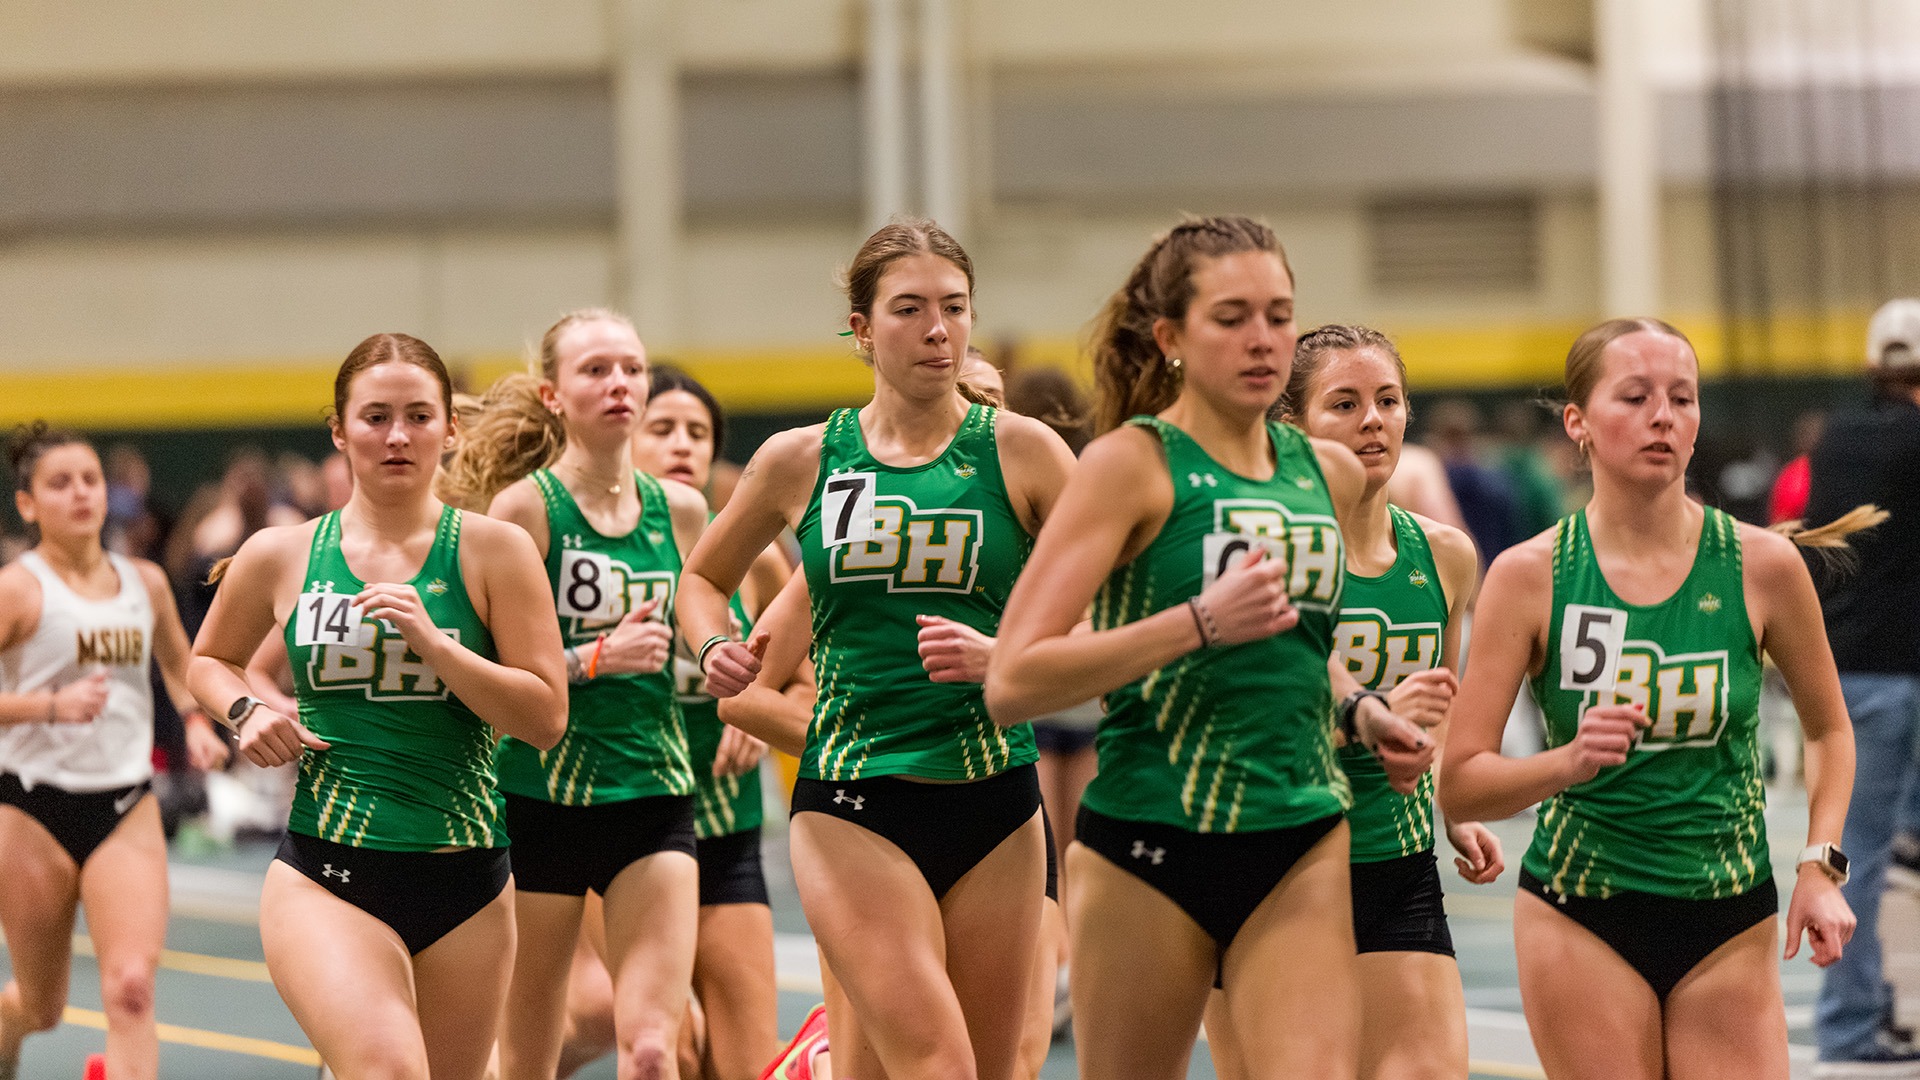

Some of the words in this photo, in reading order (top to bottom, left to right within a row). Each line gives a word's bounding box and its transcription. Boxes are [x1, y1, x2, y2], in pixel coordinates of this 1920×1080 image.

[828, 478, 866, 540] 7
[842, 506, 971, 585] BH
[567, 558, 602, 612] 8
[77, 628, 142, 665] MSUB
[310, 597, 351, 642] 14
[1572, 612, 1612, 684] 5
[320, 623, 439, 692] BH
[1333, 620, 1436, 690] BH
